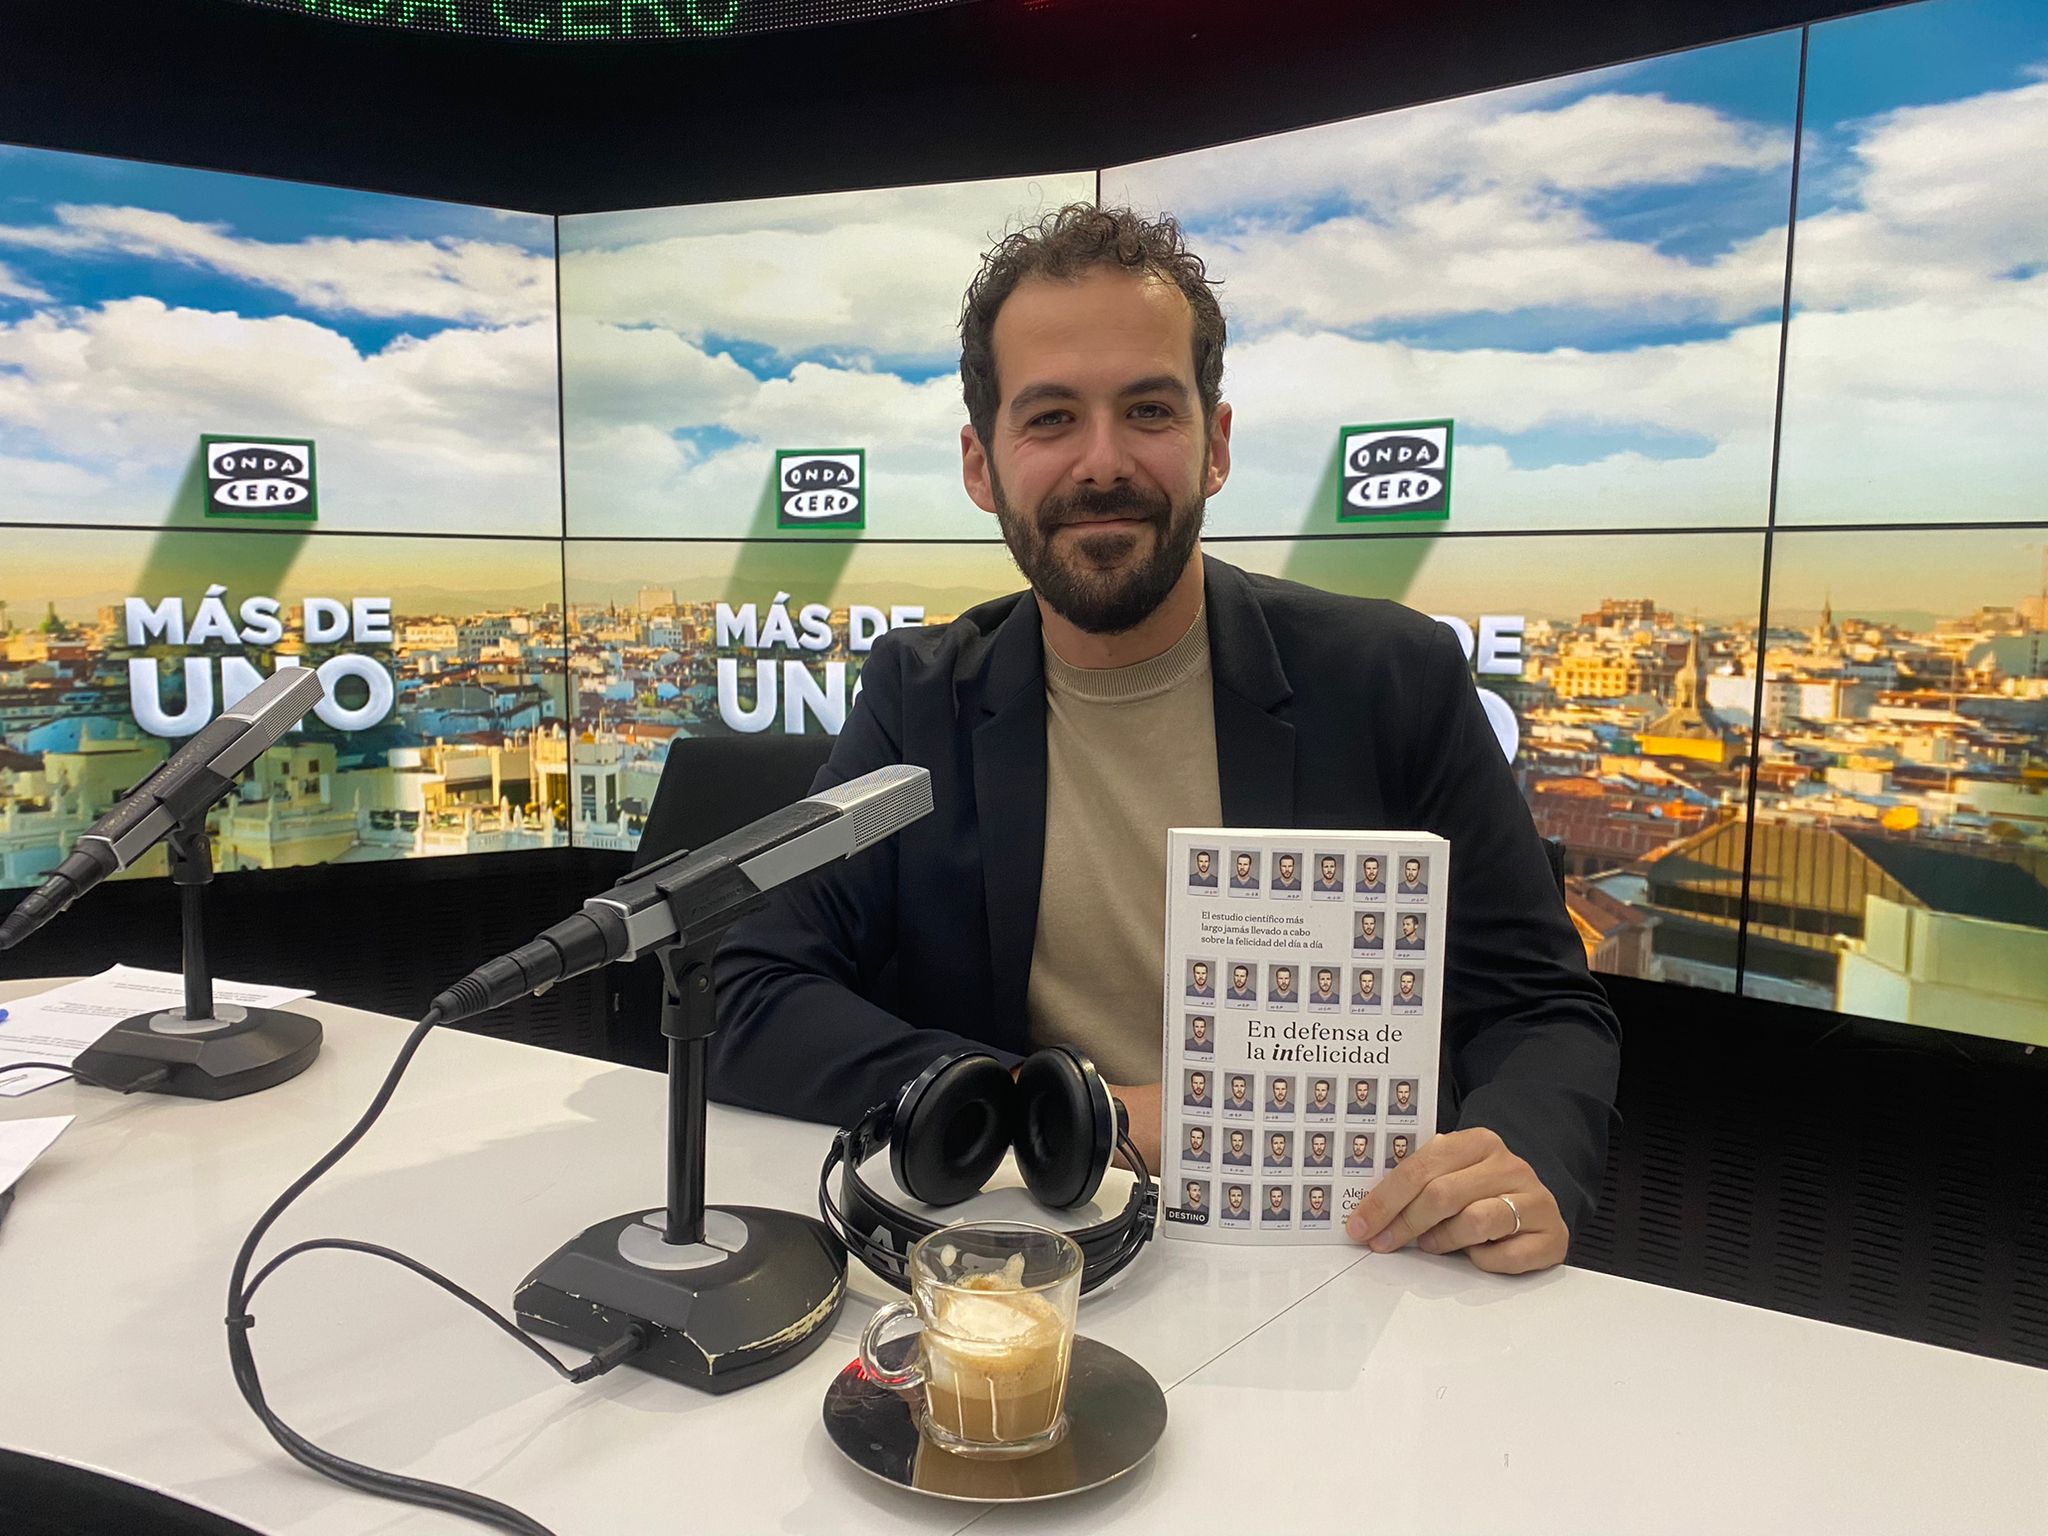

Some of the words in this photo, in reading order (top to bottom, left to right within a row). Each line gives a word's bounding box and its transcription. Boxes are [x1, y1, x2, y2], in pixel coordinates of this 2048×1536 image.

[221, 455, 296, 472] ONDA
[1356, 445, 1431, 467] ONDA
[790, 468, 850, 485] ONDA
[227, 484, 297, 501] CERO
[1360, 479, 1430, 501] CERO
[794, 495, 849, 512] CERO
[124, 583, 284, 646] MÁS
[303, 597, 393, 644] DE
[715, 591, 833, 651] MÁS
[716, 657, 863, 736] UN
[1201, 911, 1211, 920] El
[1211, 913, 1244, 922] estudio
[1244, 914, 1285, 924] científico
[1286, 915, 1304, 925] más
[1201, 922, 1223, 934] largo
[1223, 925, 1250, 935] jamás
[1251, 926, 1282, 936] llevado
[1282, 928, 1289, 936] a
[1289, 927, 1311, 937] cabo
[1201, 935, 1226, 945] sobre
[1226, 936, 1234, 945] la
[1235, 937, 1272, 947] felicidad
[1273, 938, 1287, 948] del
[1287, 939, 1302, 949] día
[1309, 940, 1323, 949] día
[1248, 1020, 1276, 1039] En
[1283, 1022, 1370, 1042] defensa
[1376, 1024, 1403, 1042] de
[1247, 1042, 1266, 1060] la
[1271, 1043, 1390, 1064] infelicidad
[1342, 1187, 1370, 1200] Aleja
[1168, 1210, 1206, 1223] DESTINO
